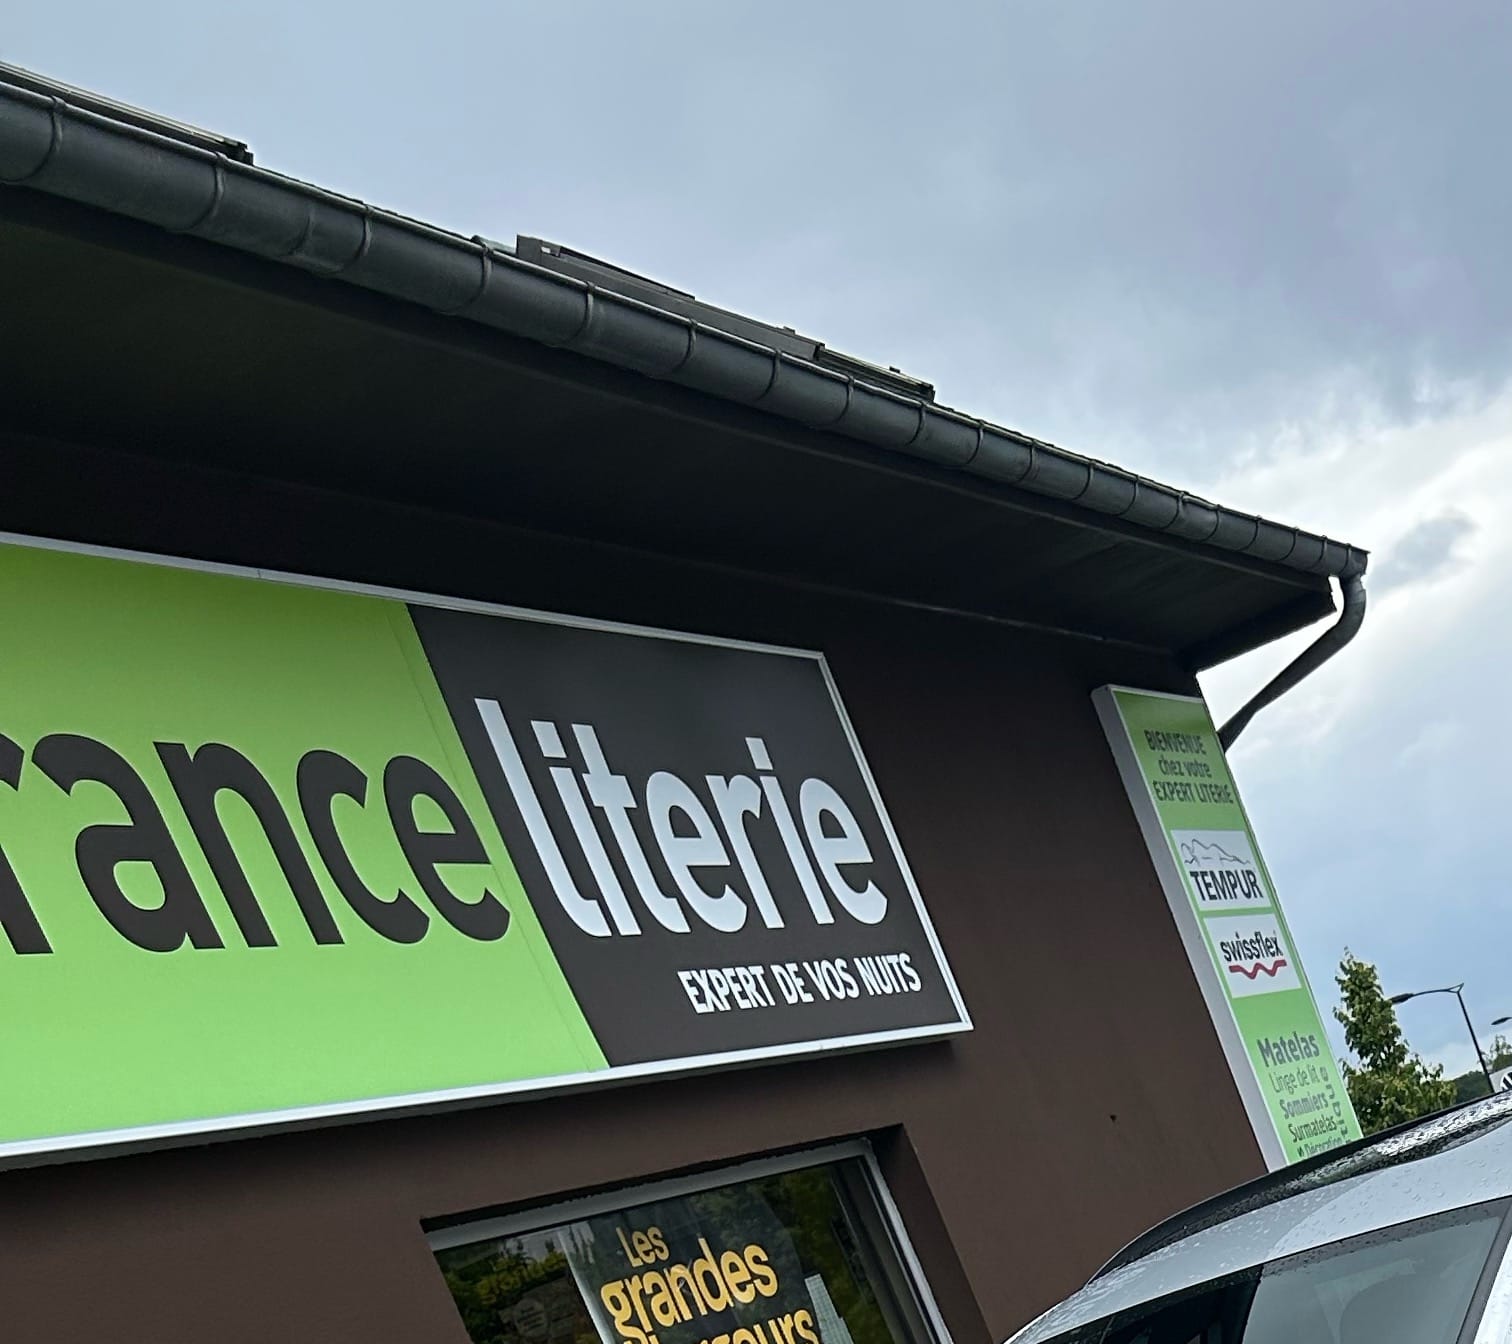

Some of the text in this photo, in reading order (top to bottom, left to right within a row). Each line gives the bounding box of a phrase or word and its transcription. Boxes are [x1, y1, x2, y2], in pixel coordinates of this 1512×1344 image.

[1144, 729, 1206, 755] BIENVENUE
[1158, 754, 1212, 778] chez votre
[1153, 780, 1233, 804] EXPERT LITERIE
[474, 698, 889, 936] literie
[1189, 869, 1263, 901] TEMPUR
[1220, 931, 1283, 962] swissflex
[677, 952, 922, 1014] EXPERT DE VOS NUITS
[1257, 1031, 1320, 1067] Matelas
[1269, 1064, 1320, 1095] Linge de lit
[1280, 1091, 1329, 1119] Sommiers
[1288, 1114, 1338, 1143] Surmatelas
[616, 1226, 670, 1267] Les
